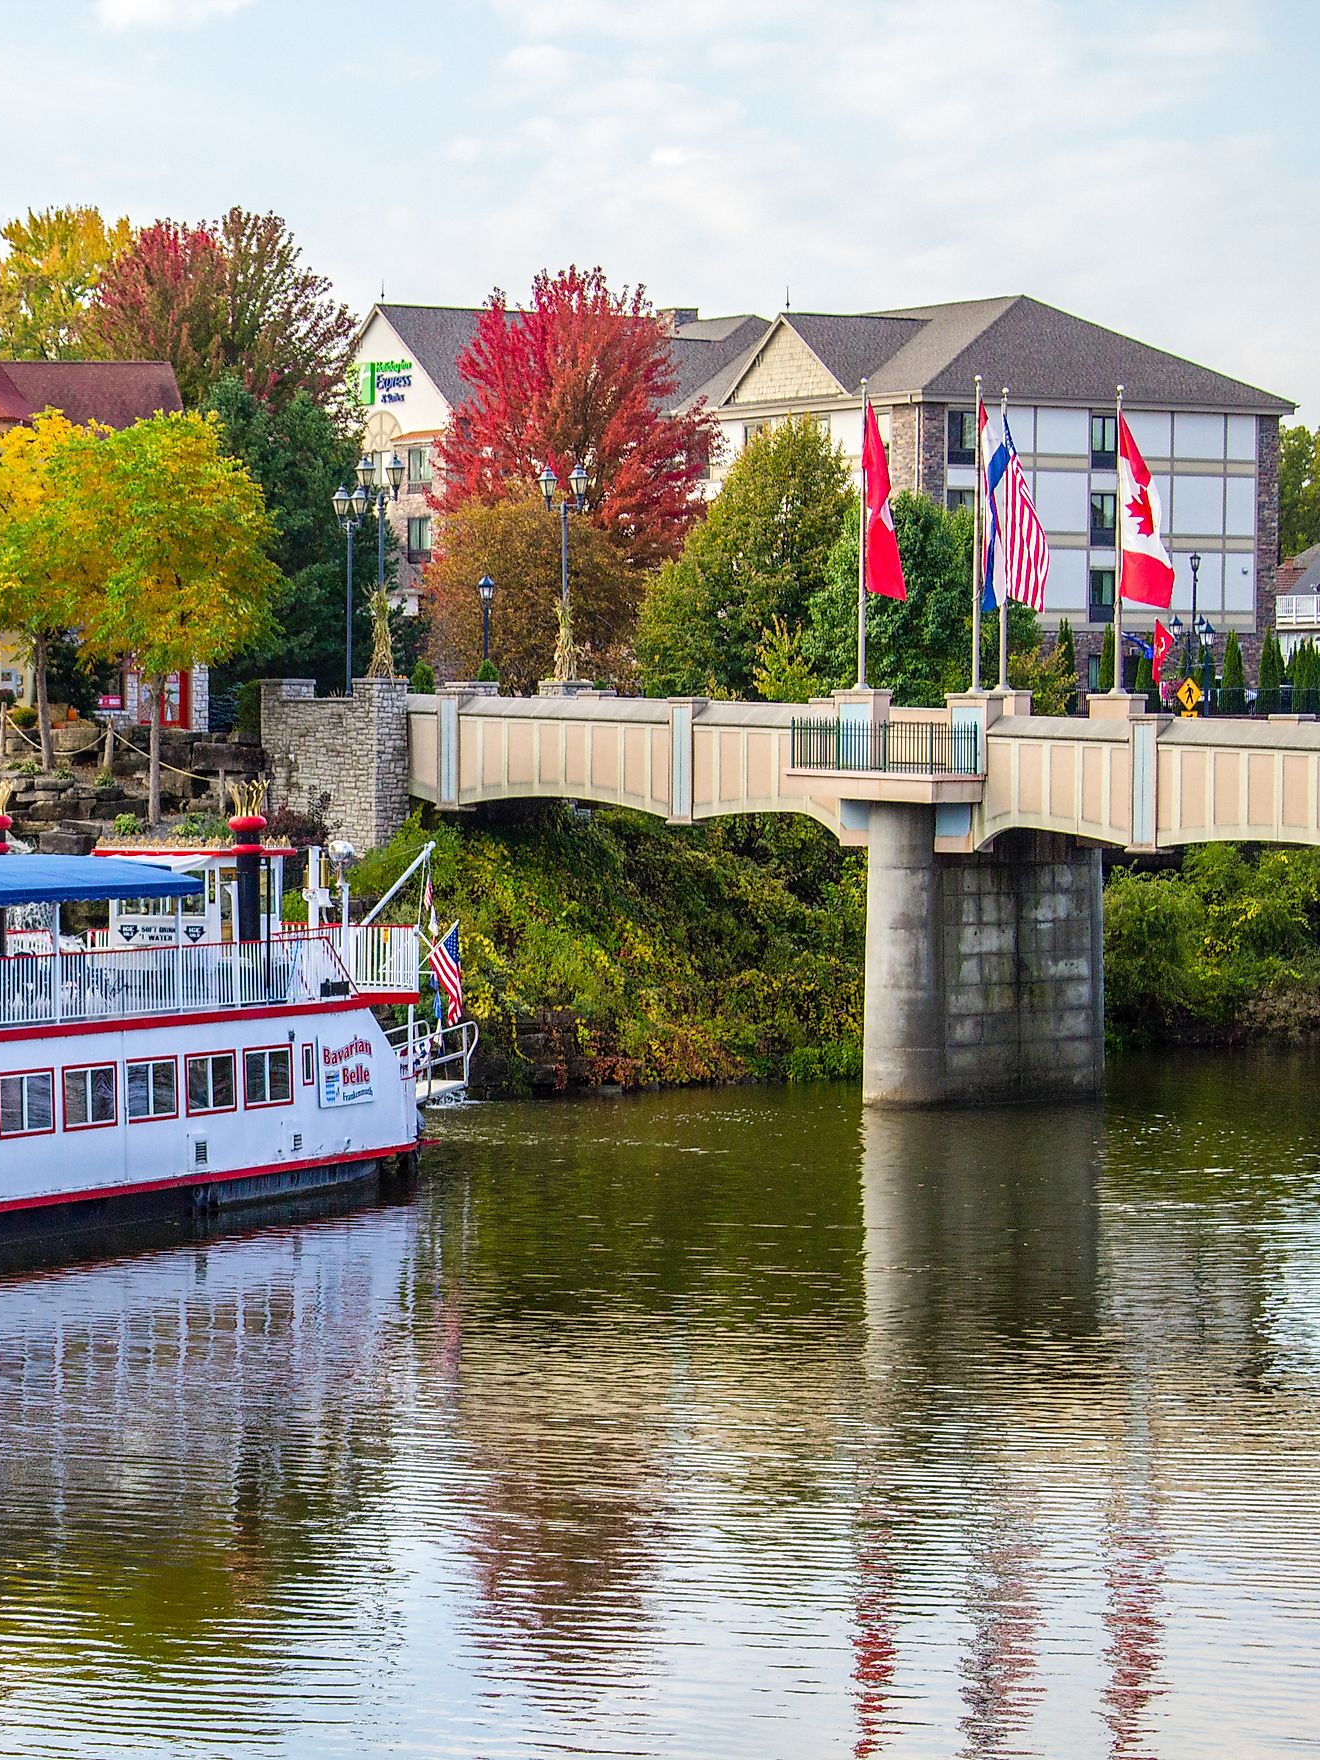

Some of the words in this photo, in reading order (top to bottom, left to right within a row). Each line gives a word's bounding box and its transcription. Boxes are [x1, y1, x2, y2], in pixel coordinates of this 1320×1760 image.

[376, 373, 412, 392] Express
[323, 1034, 372, 1067] Bavarian
[342, 1063, 371, 1087] Belle
[342, 1087, 373, 1101] Frankenmuth
